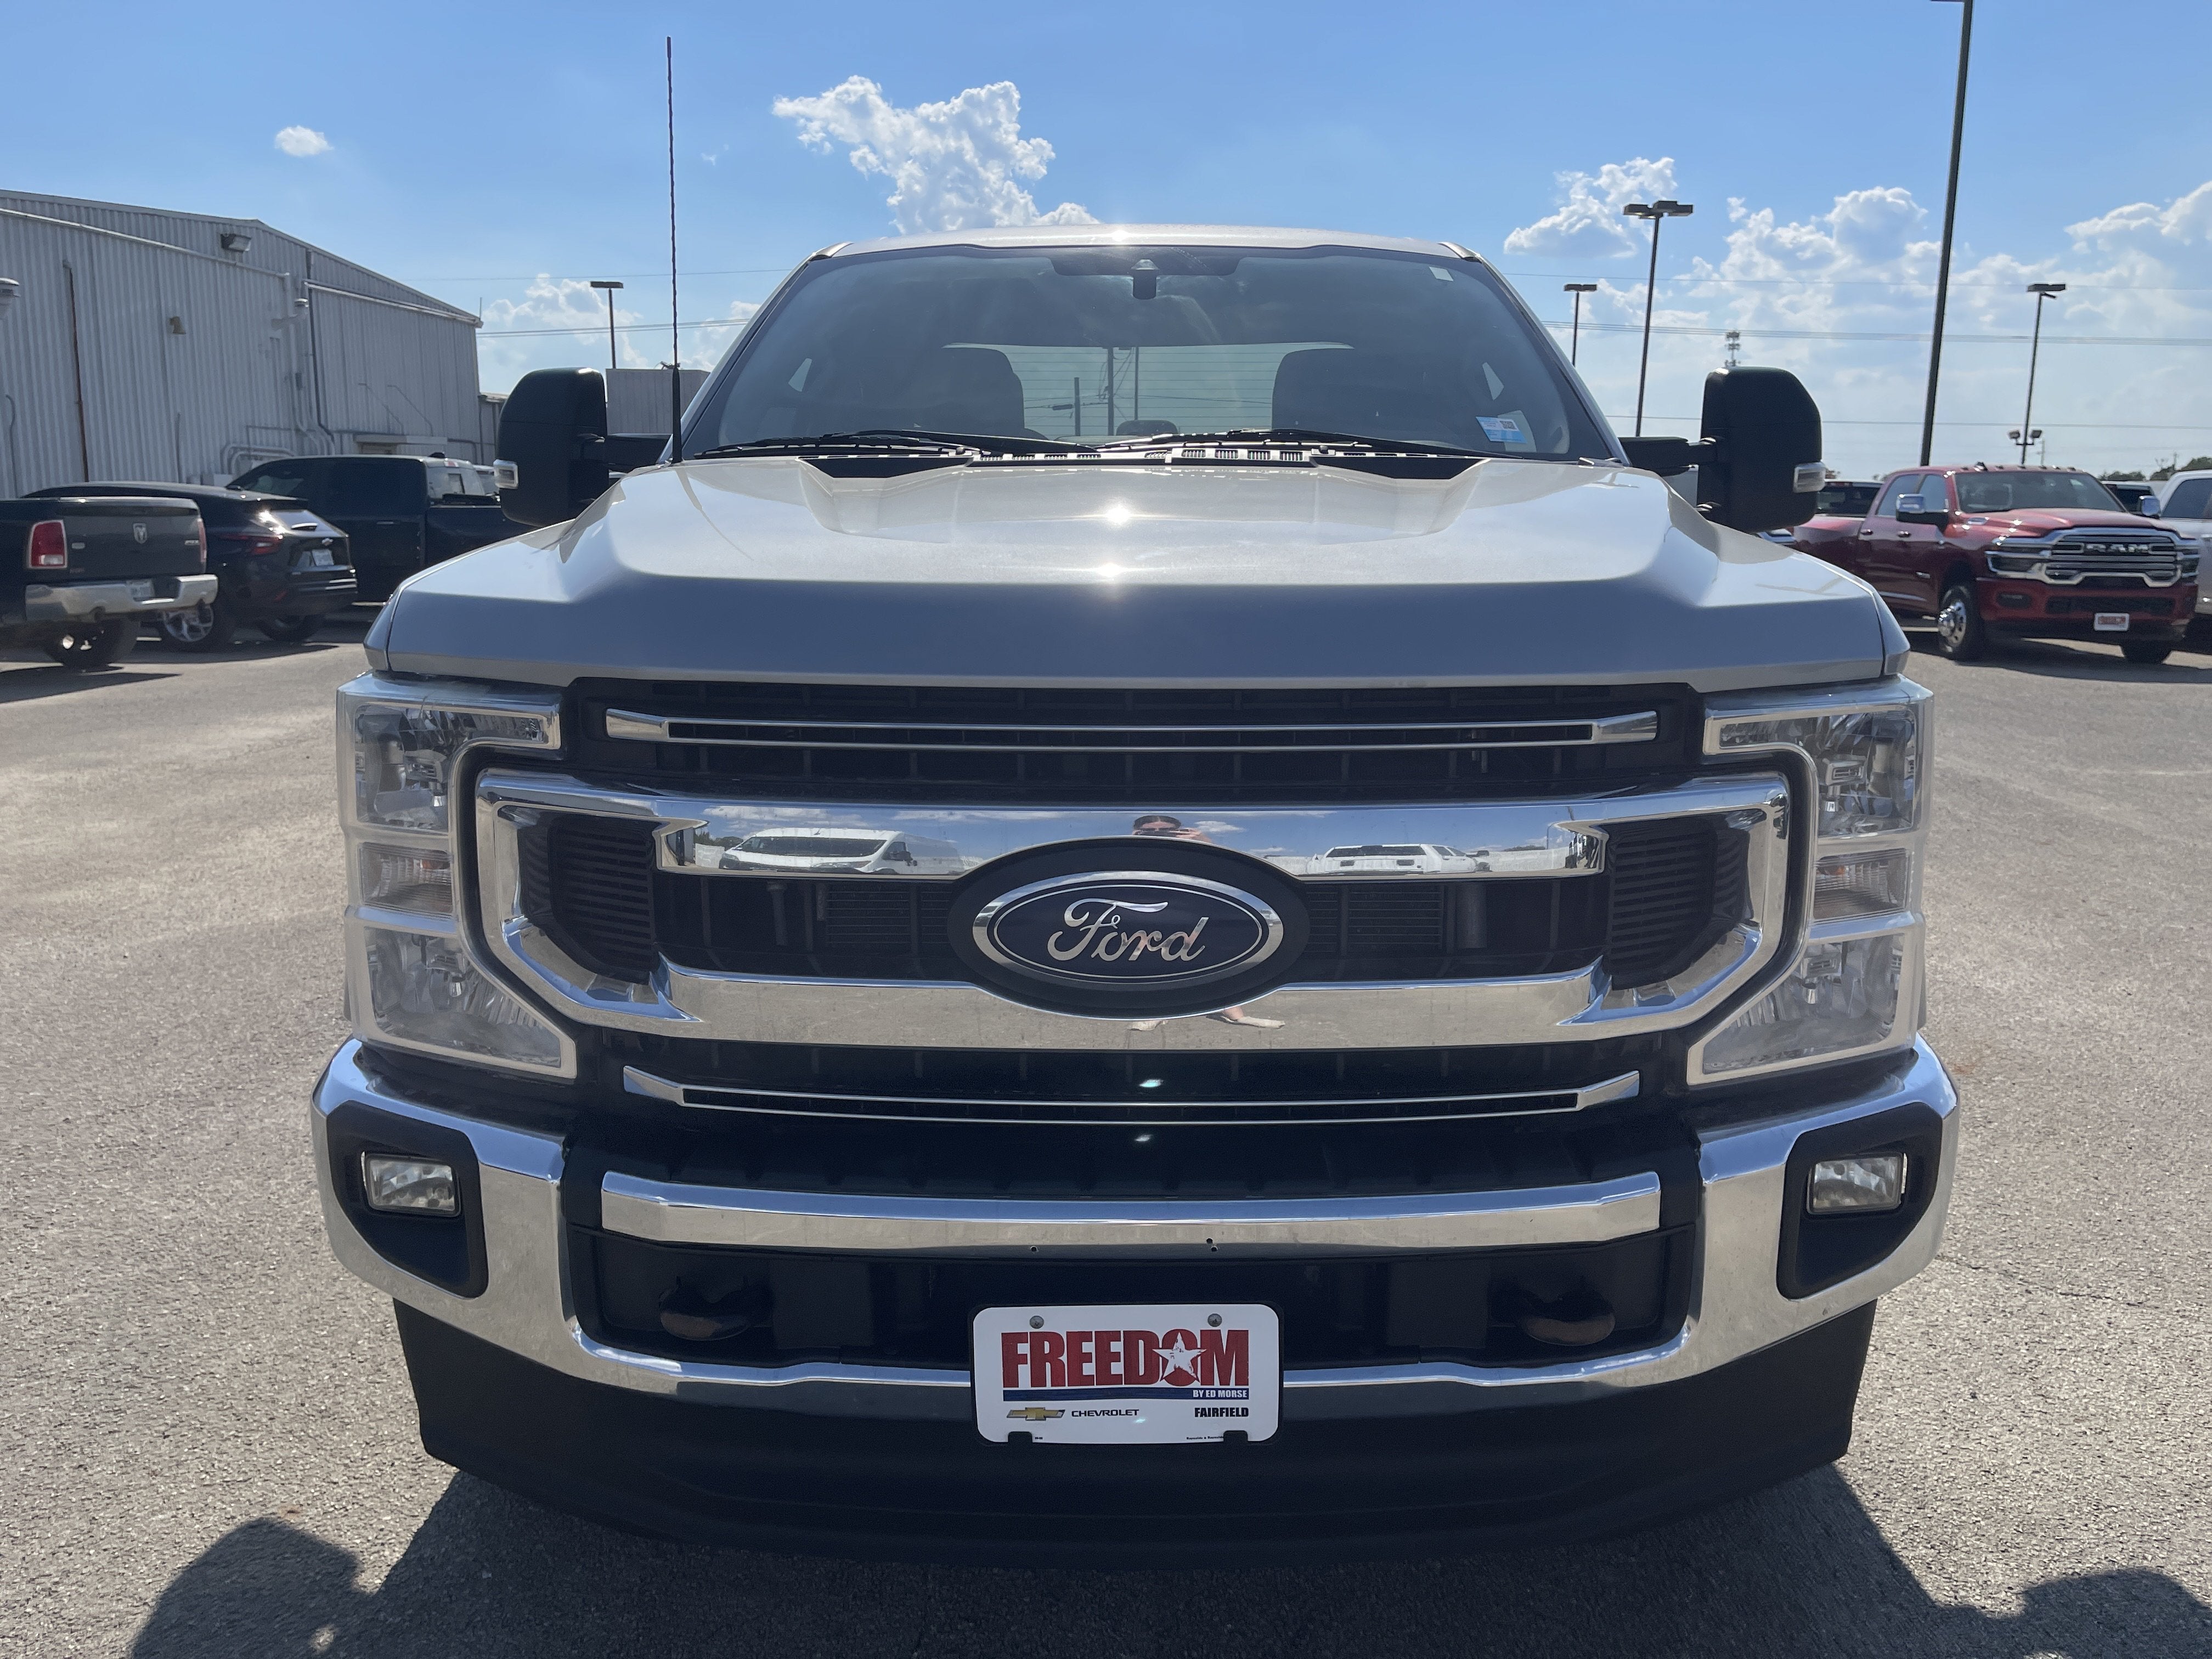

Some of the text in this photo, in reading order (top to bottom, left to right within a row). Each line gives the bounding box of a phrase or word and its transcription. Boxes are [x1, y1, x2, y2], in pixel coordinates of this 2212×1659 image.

[1047, 898, 1210, 962] Ford
[1001, 1329, 1249, 1388] FREEDOM
[1193, 1390, 1247, 1398] BY ED MORSE
[1071, 1409, 1139, 1417] CHEVROLET
[1194, 1407, 1249, 1418] FAIRFIELD
